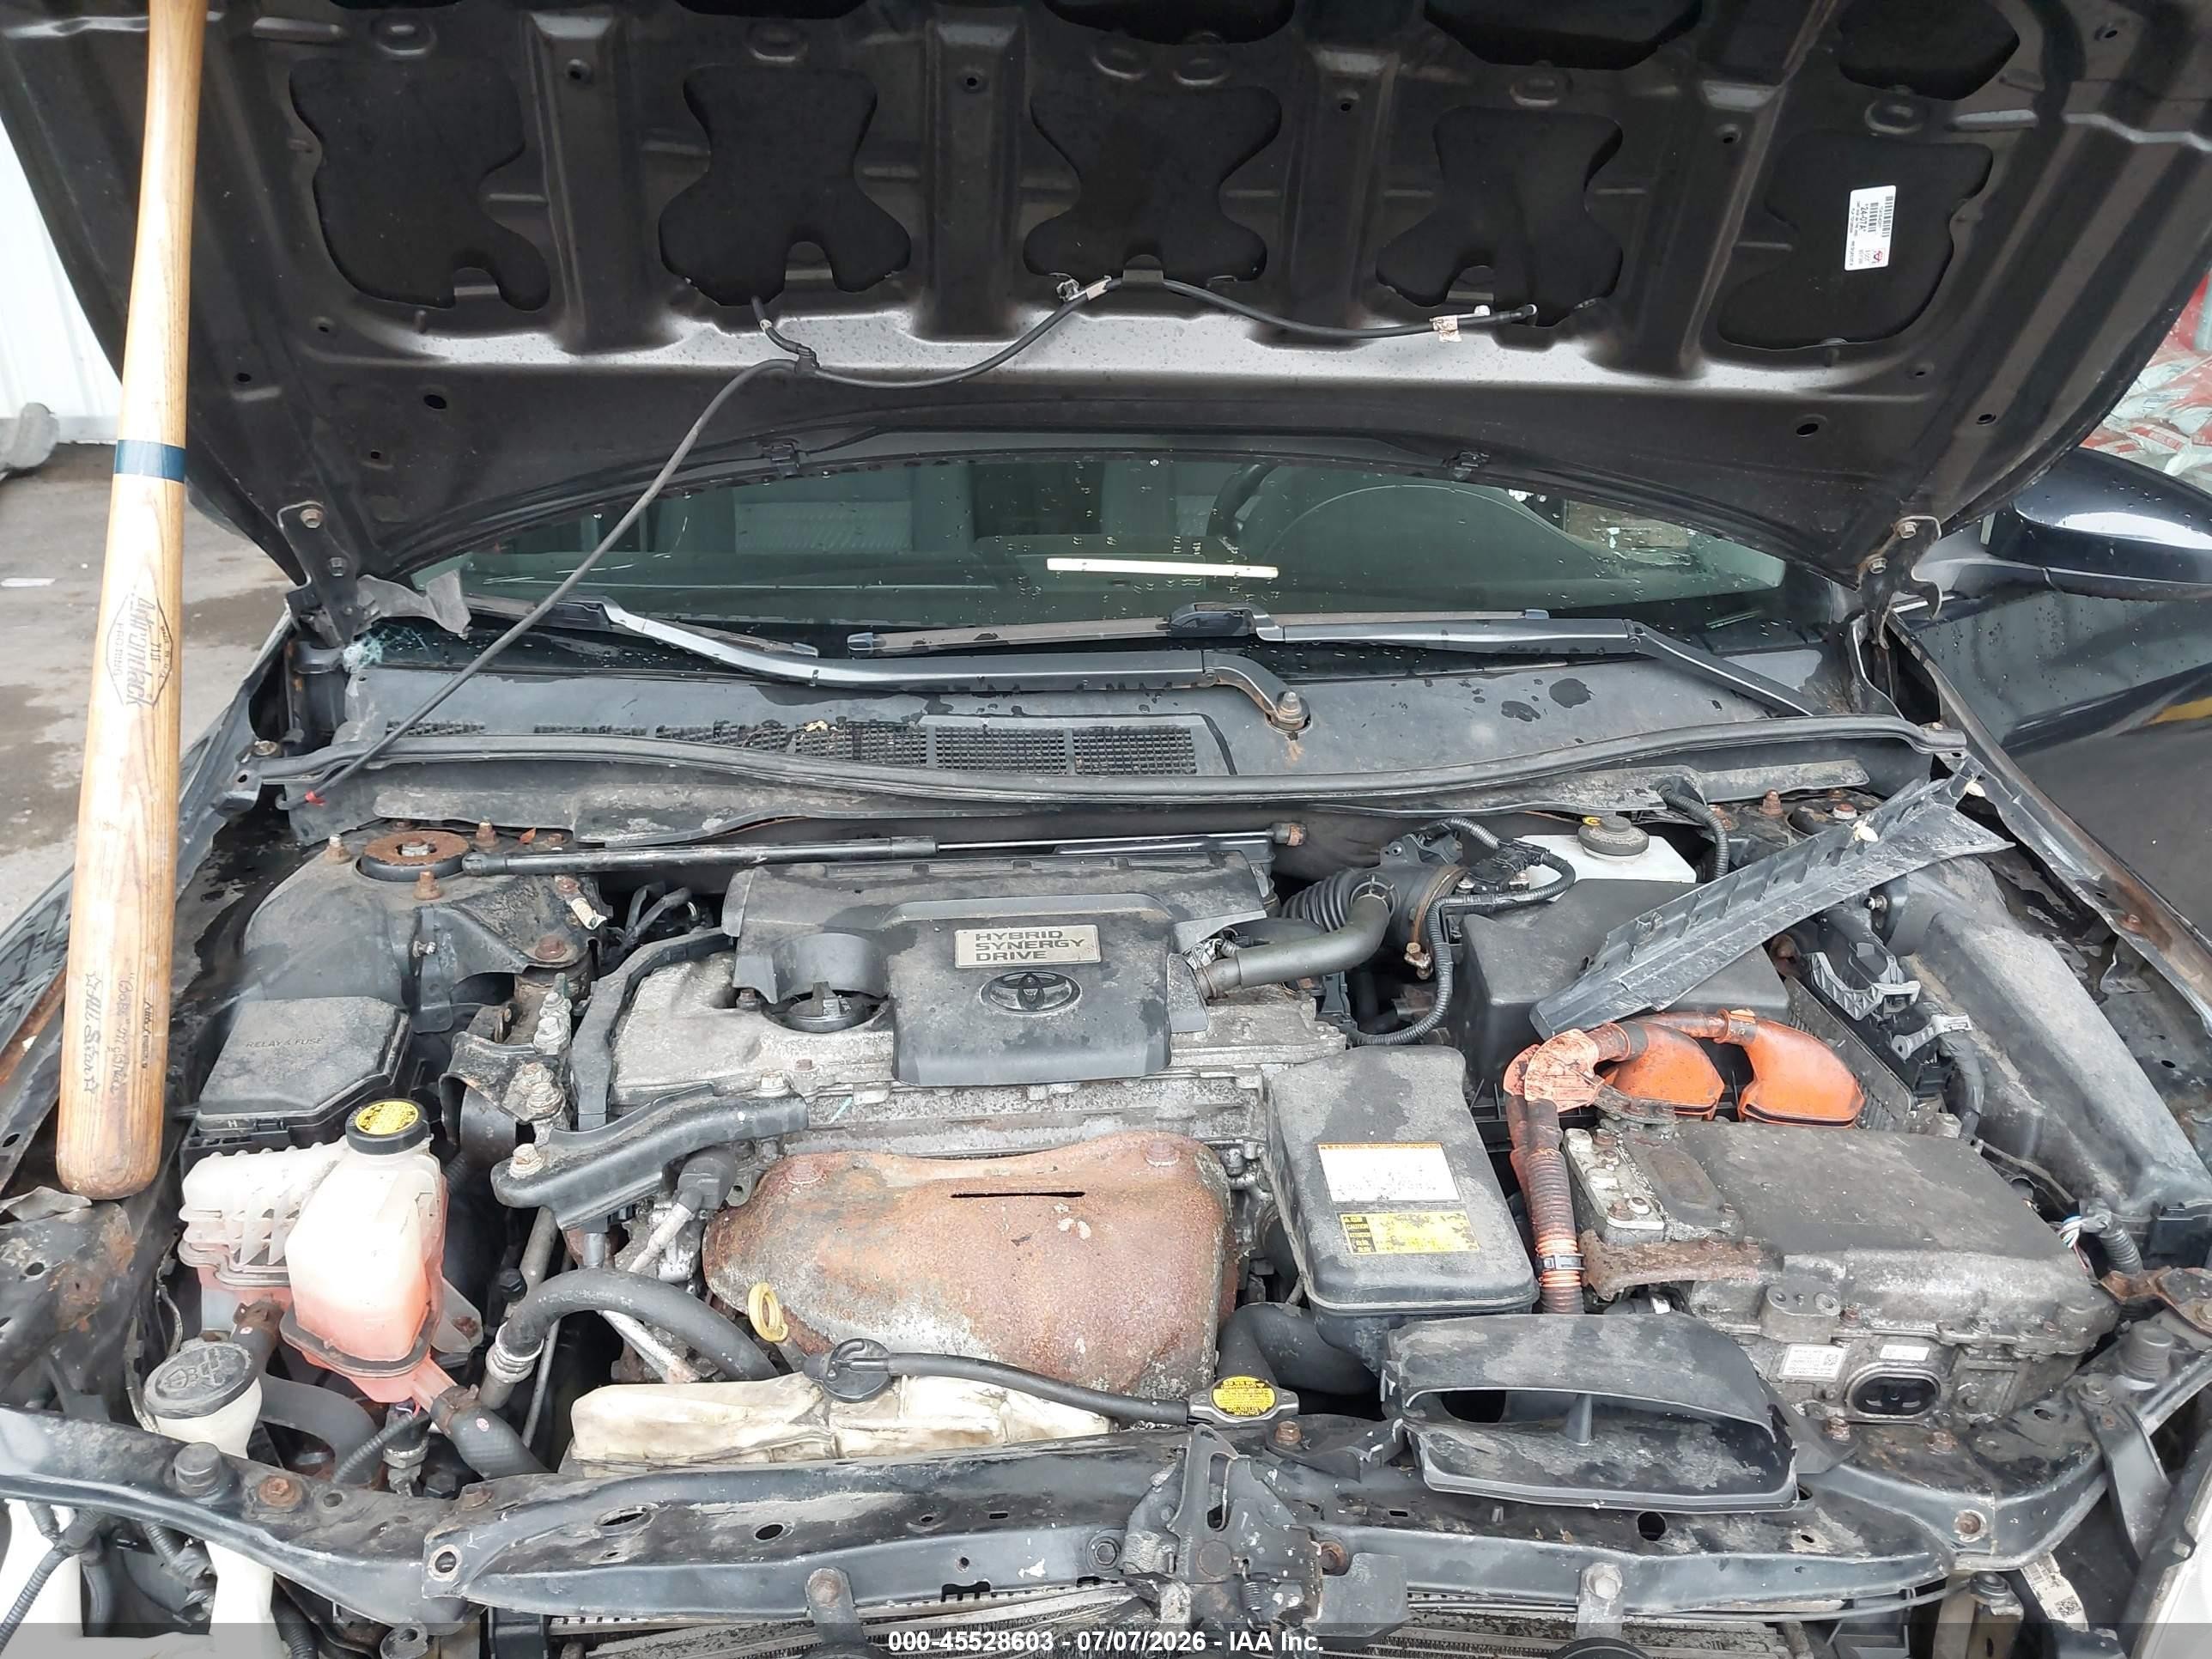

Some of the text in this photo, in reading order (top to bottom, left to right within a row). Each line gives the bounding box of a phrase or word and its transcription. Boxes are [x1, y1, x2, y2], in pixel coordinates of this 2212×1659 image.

[975, 930, 1063, 941] HYBRID
[975, 939, 1085, 951] SYNERGY
[975, 950, 1048, 962] DRIVE
[246, 1039, 283, 1048] RELAY
[295, 1036, 324, 1046] FUSE
